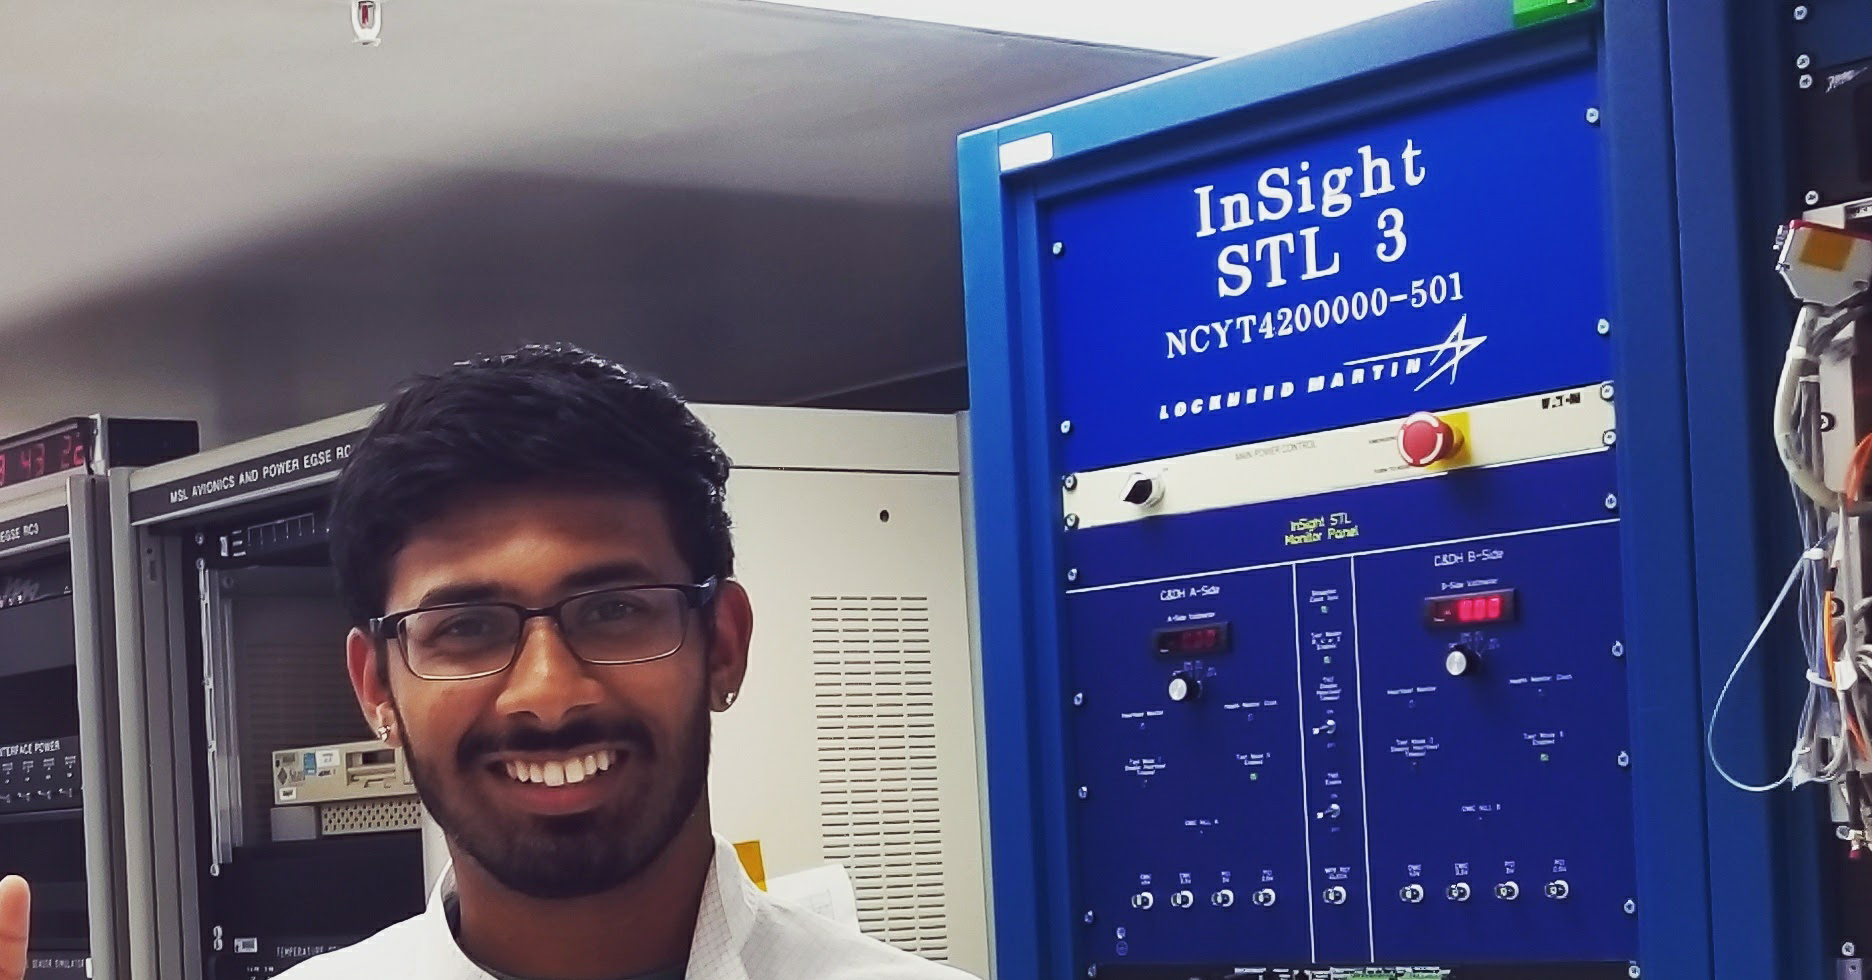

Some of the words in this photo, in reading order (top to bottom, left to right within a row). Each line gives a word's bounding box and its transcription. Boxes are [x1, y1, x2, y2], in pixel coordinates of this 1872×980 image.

[1193, 138, 1426, 238] InSight
[1217, 226, 1340, 298] STL
[1376, 207, 1407, 262] 3
[1166, 271, 1464, 359] NCYT4200000-501
[1159, 381, 1295, 420] LOCKHEED
[1307, 357, 1422, 393] MARTIN
[170, 487, 189, 503] MSL
[191, 476, 235, 497] AVIONICS
[239, 469, 259, 486] AND
[262, 458, 300, 479] POWER
[303, 449, 332, 468] EGSE
[0, 527, 21, 543] EGSE
[34, 740, 60, 754] POWER
